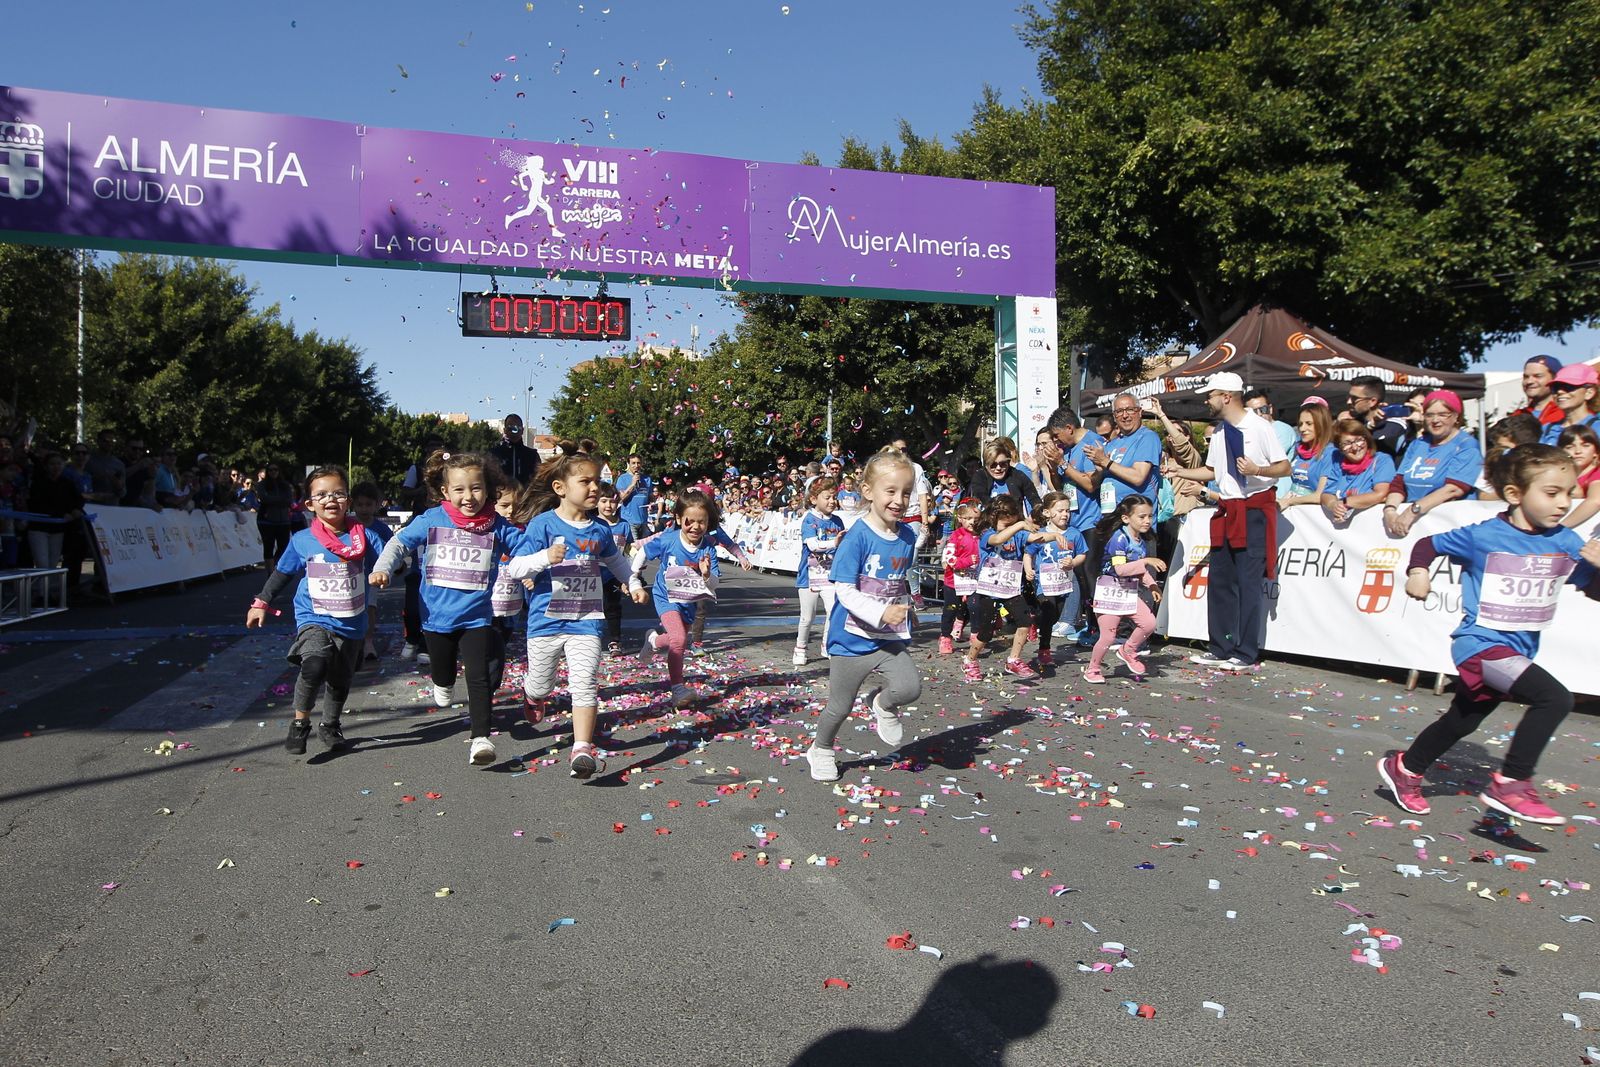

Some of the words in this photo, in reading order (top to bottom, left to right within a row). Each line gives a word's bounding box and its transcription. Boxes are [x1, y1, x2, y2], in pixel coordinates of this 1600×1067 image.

[93, 135, 309, 187] ALMERÍA
[562, 158, 618, 185] VIII
[93, 176, 204, 207] CIUDAD
[561, 186, 621, 199] CARRERA
[373, 234, 402, 250] LA
[409, 236, 529, 258] IGUALDAD
[537, 243, 562, 260] ES
[570, 246, 668, 267] NUESTRA
[437, 545, 481, 563] 3102
[319, 577, 357, 592] 3240
[563, 578, 597, 593] 3214
[1103, 588, 1130, 598] 3151
[1499, 577, 1557, 598] 3018
